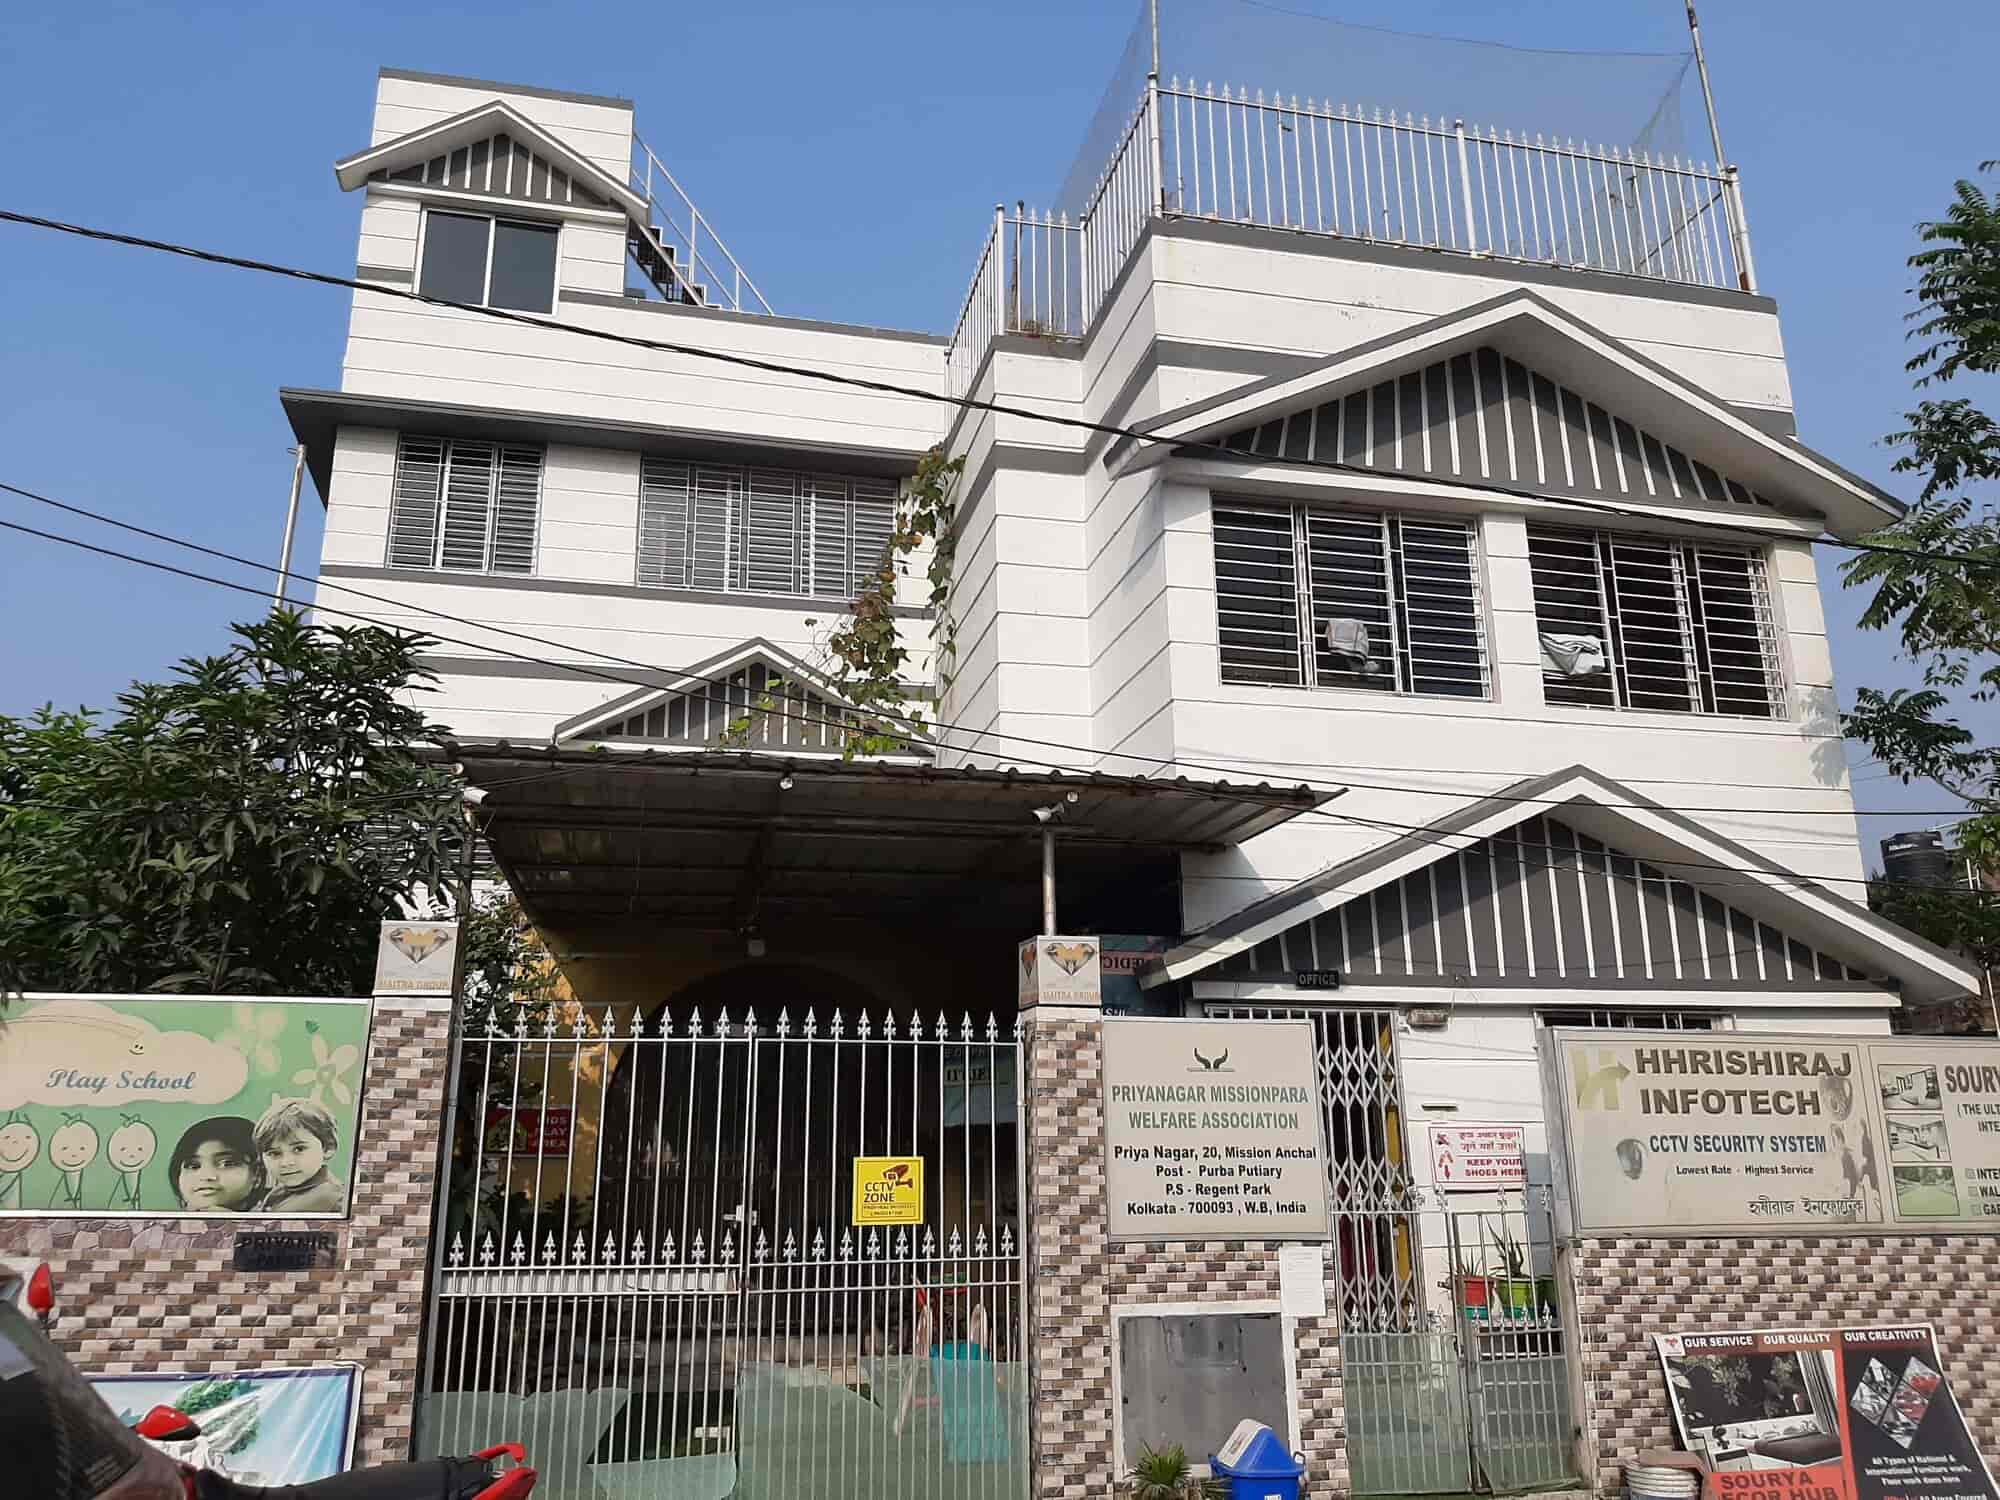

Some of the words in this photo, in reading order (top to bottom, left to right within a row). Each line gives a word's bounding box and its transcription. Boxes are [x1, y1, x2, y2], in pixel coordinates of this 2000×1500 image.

[1299, 974, 1337, 985] OFFICE
[1634, 1048, 1852, 1077] HHRISHIRAJ
[45, 1069, 108, 1095] Play
[116, 1069, 196, 1090] School
[1111, 1085, 1206, 1103] PRIYANAGAR
[1210, 1086, 1309, 1104] MISSIONPARA
[1640, 1088, 1822, 1115] INFOTECH
[1963, 1103, 1982, 1115] THE
[1129, 1111, 1198, 1129] WELFARE
[1201, 1112, 1299, 1129] ASSOCIATION
[1649, 1135, 1689, 1153] CCTV
[1694, 1135, 1766, 1153] SECURITY
[1770, 1135, 1827, 1153] SYSTEM
[1114, 1146, 1149, 1162] Priya
[1153, 1146, 1199, 1162] Nagar,
[1202, 1146, 1222, 1160] 20,
[1225, 1146, 1271, 1159] Mission
[1275, 1147, 1317, 1159] Anchal
[1466, 1158, 1493, 1166] KEEP
[1156, 1165, 1183, 1177] Post
[1199, 1165, 1235, 1177] Purba
[1238, 1165, 1283, 1180] Putiary
[1465, 1169, 1498, 1177] SHOES
[1501, 1168, 1528, 1177] HERE
[1676, 1165, 1709, 1175] Lowest
[1712, 1165, 1732, 1175] Rate
[1744, 1165, 1779, 1177] Highest
[1781, 1165, 1814, 1175] Service
[864, 1181, 894, 1192] CCTV
[1166, 1183, 1184, 1196] P.S
[1195, 1184, 1240, 1198] Regent
[1243, 1183, 1272, 1196] Park
[864, 1193, 895, 1203] ZONE
[1127, 1202, 1177, 1215] Kolkata
[1187, 1202, 1233, 1214] 700093
[1276, 1201, 1307, 1214] India
[1684, 1336, 1707, 1348] OUR
[1709, 1335, 1753, 1347] SERVICE
[1763, 1334, 1787, 1345] OUR
[1789, 1333, 1831, 1344] QUALITY
[1844, 1330, 1872, 1342] OUR
[1874, 1329, 1928, 1342] CREATIVITY
[1720, 1471, 1814, 1491] SOURYA
